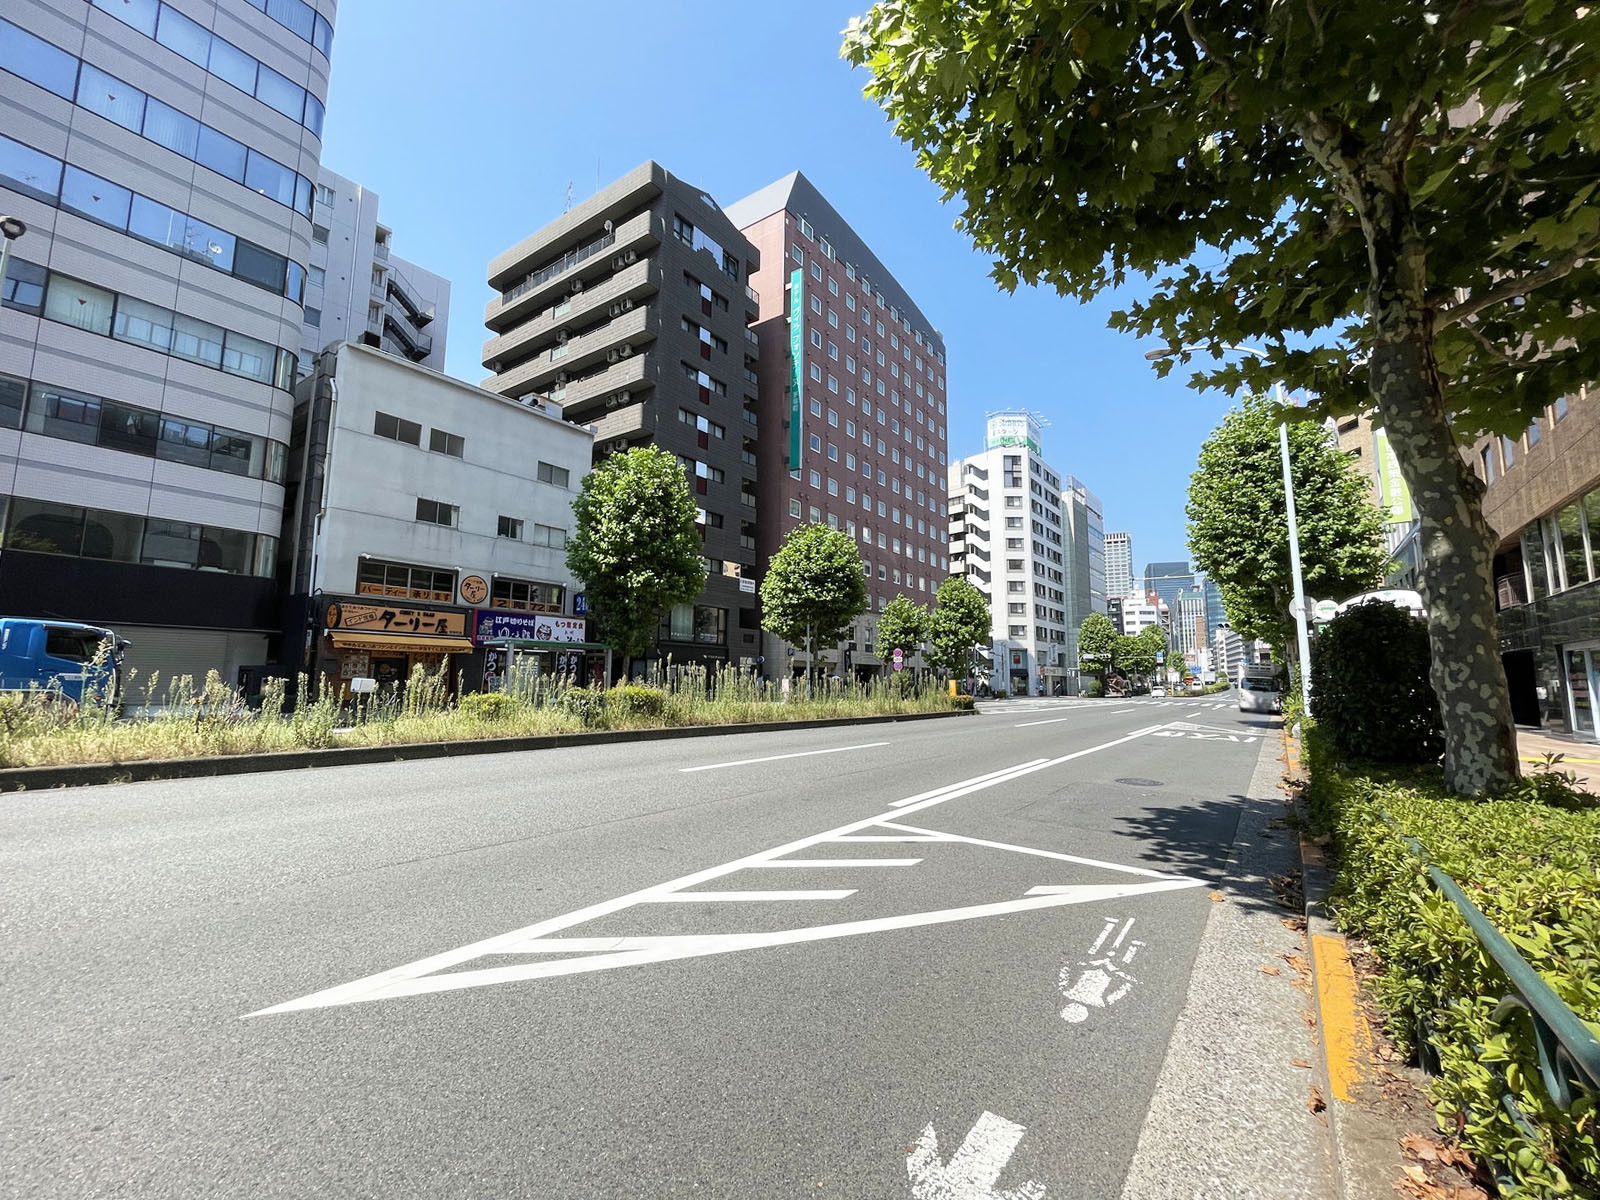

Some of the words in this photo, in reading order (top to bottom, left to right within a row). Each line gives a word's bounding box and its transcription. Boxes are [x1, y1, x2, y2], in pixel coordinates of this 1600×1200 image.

[464, 582, 485, 592] ターリー
[379, 610, 448, 635] ターリー屋
